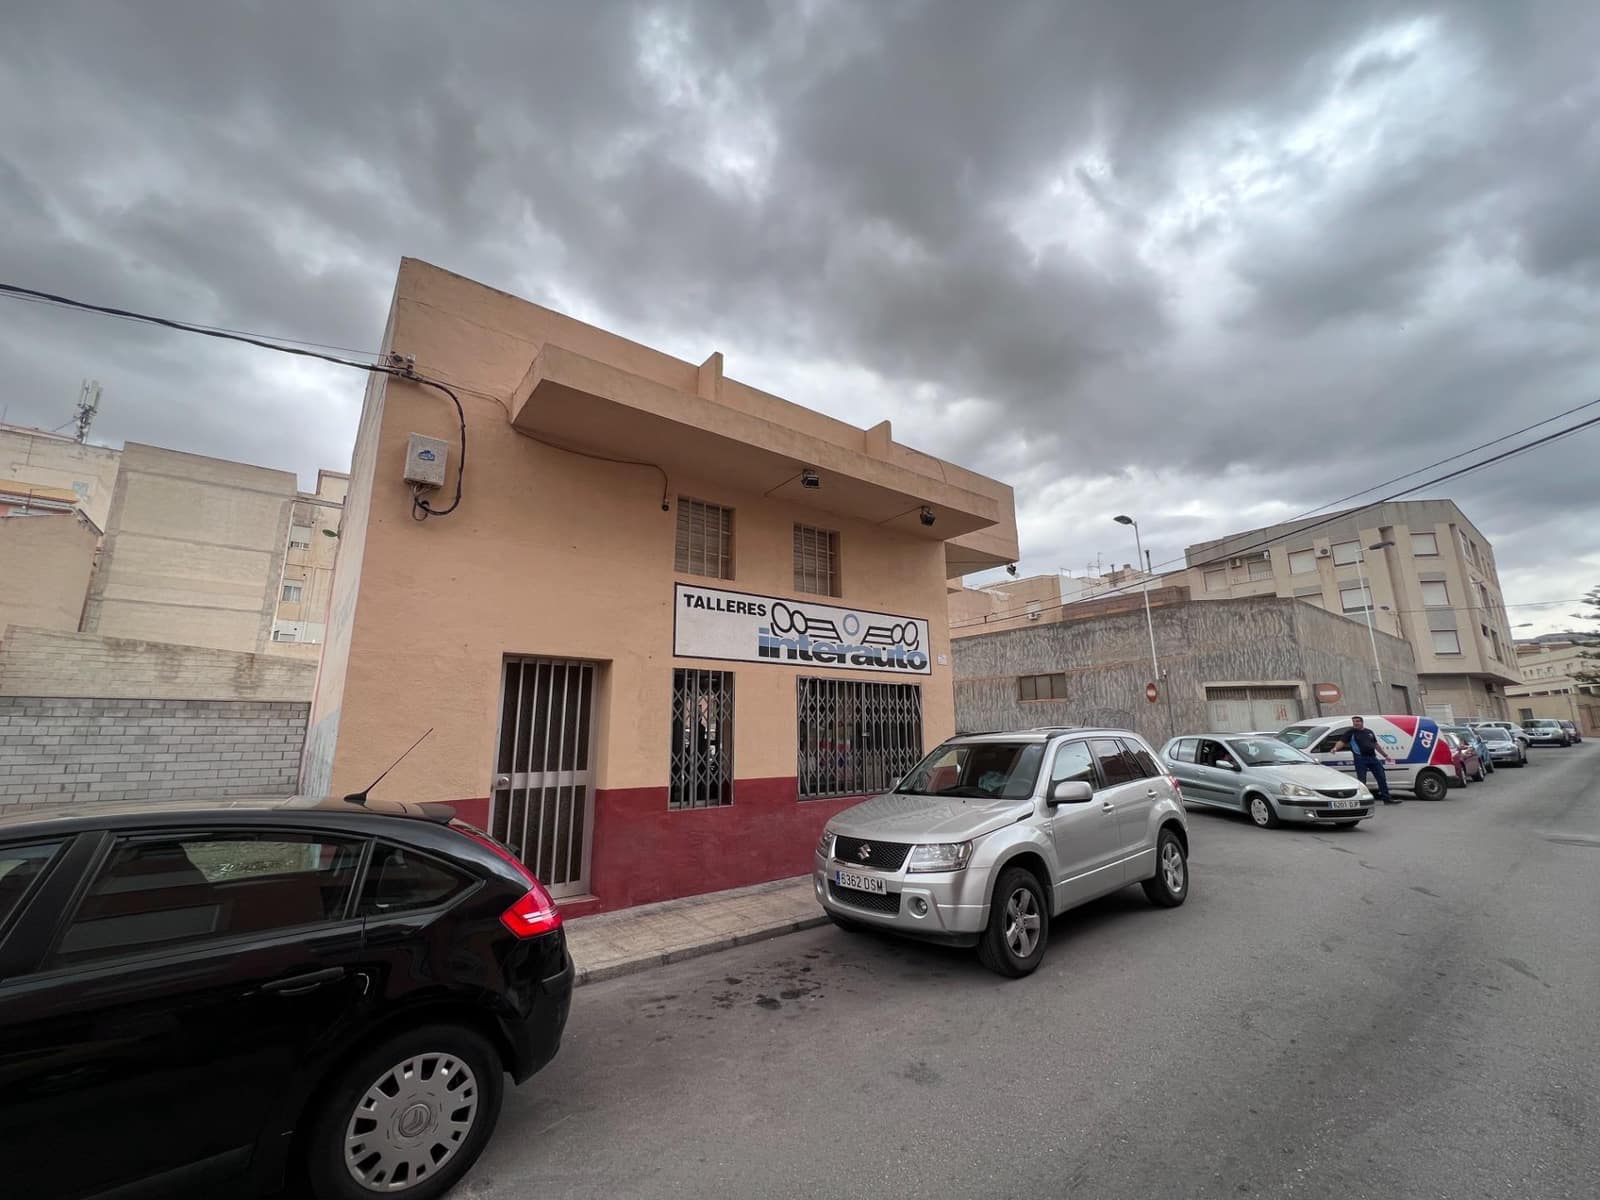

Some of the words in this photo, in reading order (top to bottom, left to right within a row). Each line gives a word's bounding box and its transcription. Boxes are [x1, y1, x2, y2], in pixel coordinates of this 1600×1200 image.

[683, 594, 767, 617] TALLERES
[758, 627, 928, 670] interauto
[841, 873, 862, 888] 6362
[863, 877, 884, 892] DSM
